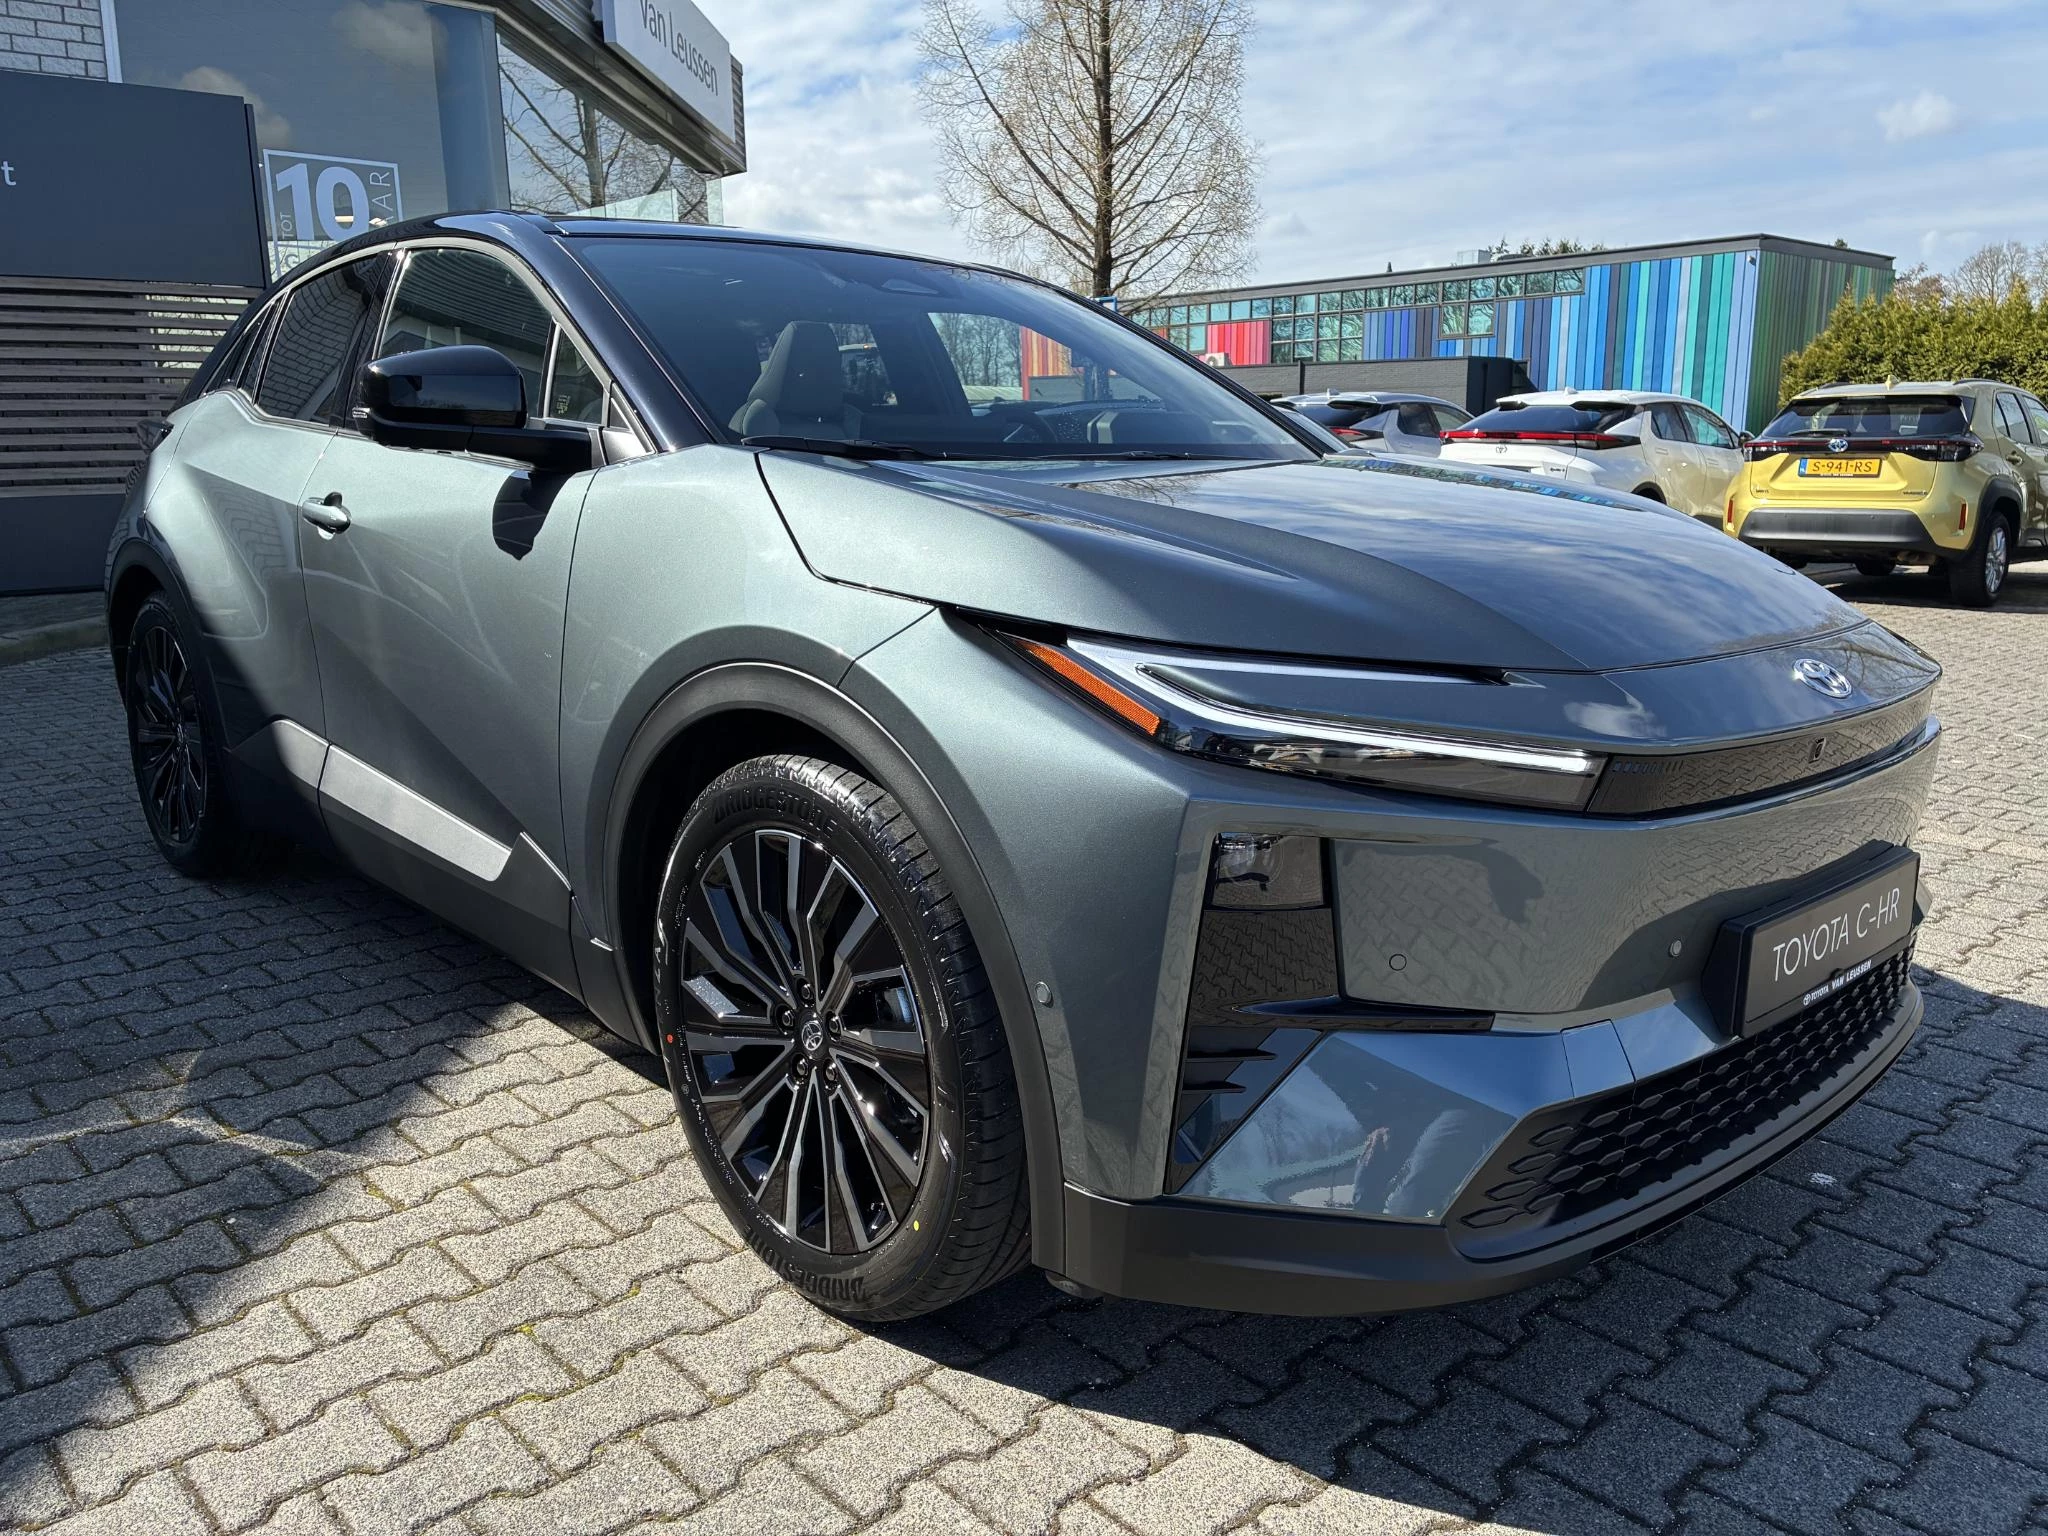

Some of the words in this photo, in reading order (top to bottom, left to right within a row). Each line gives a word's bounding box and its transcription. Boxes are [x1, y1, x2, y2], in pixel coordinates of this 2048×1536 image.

[640, 0, 666, 48] Van
[669, 11, 718, 96] Leussen
[275, 162, 370, 242] 10
[280, 211, 295, 239] TOT
[1812, 461, 1873, 473] S-941-RS
[1773, 913, 1849, 982] TOYOTA
[1856, 887, 1900, 938] C-HR
[1811, 984, 1829, 1001] TOYOTA
[1831, 976, 1844, 990] VAN
[1846, 959, 1872, 982] LEUSSEN
